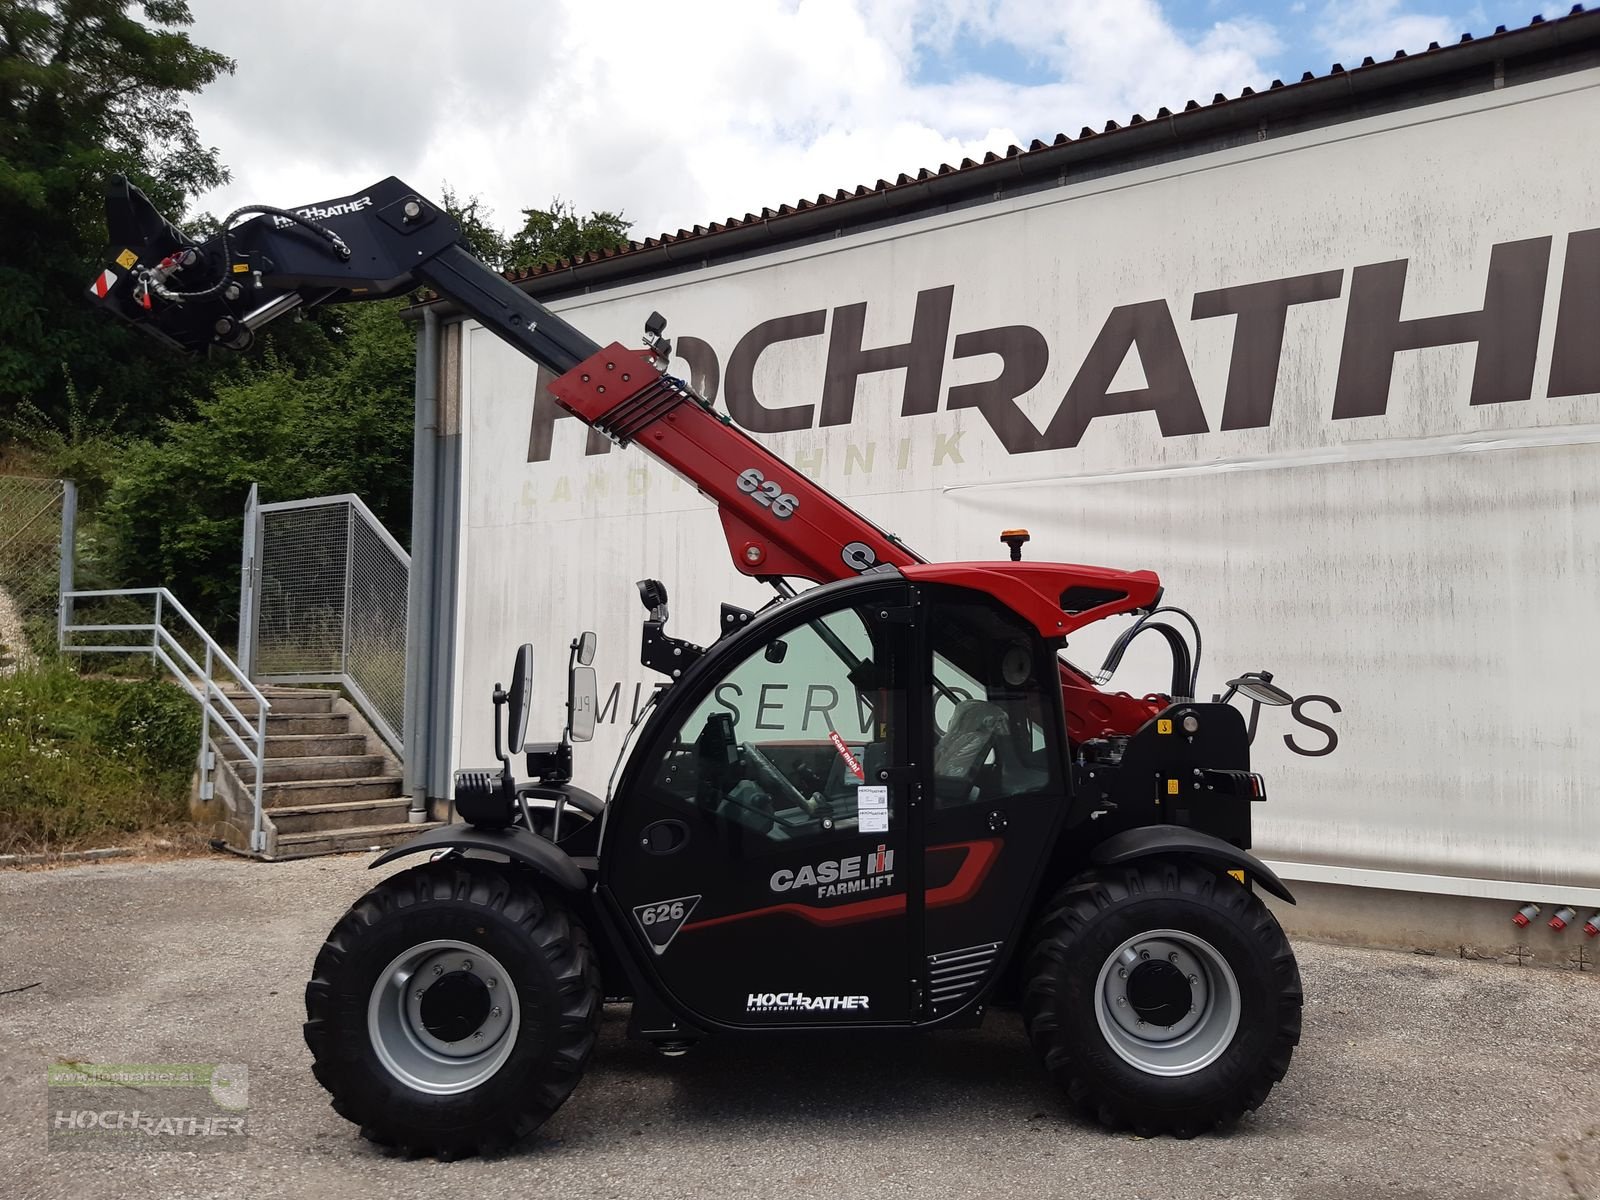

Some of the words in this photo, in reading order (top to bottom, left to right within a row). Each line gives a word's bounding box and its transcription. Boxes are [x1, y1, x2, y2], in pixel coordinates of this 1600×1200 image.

[736, 468, 800, 518] 626
[831, 733, 846, 753] Scan
[842, 752, 861, 773] mich!
[770, 856, 861, 891] CASE
[818, 874, 894, 898] FARMLIFT
[642, 901, 684, 925] 626
[747, 992, 869, 1010] HOCHRATHER
